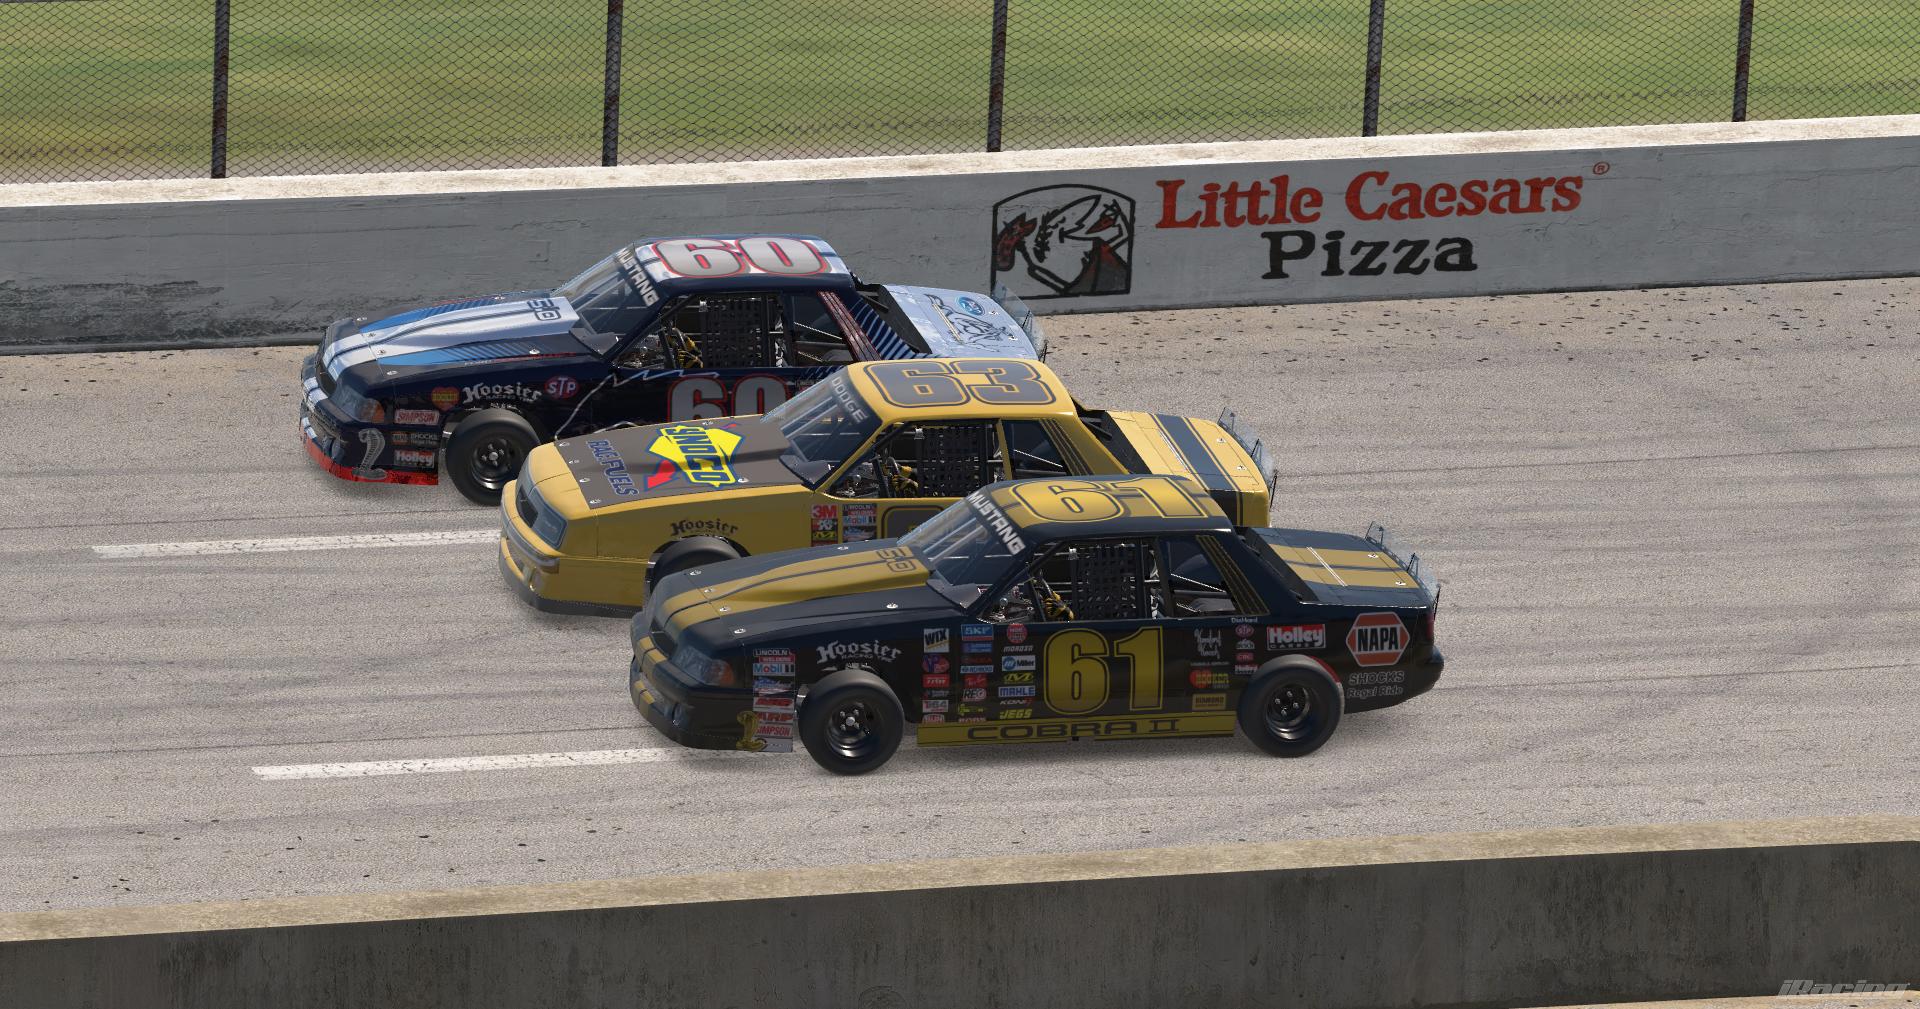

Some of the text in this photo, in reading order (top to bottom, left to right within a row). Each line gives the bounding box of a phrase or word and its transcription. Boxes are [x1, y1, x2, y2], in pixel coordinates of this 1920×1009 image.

[1155, 170, 1584, 229] Little Caesars
[651, 237, 831, 278] 60
[1261, 230, 1478, 280] Pizza
[616, 247, 660, 307] MUSTANG
[462, 382, 543, 404] Hoosier
[546, 377, 578, 396] STP
[862, 359, 1057, 408] 63
[831, 377, 869, 424] DODGE
[397, 411, 437, 424] SIMPSON
[395, 451, 434, 467] Holley
[1009, 477, 1208, 523] 61
[813, 504, 837, 519] 3M
[671, 518, 739, 536] Hoosier
[967, 492, 1027, 555] MUSTANG
[924, 630, 947, 646] WIX
[965, 626, 991, 635] SKF
[1268, 625, 1324, 647] Holley
[1357, 627, 1399, 652] NAPA
[816, 640, 902, 665] Hoosier
[753, 663, 783, 673] Mobil
[1043, 625, 1164, 716] 61
[1349, 671, 1405, 685] SHOCKS
[1000, 687, 1035, 696] MAHLE
[1001, 709, 1033, 719] JEGS
[967, 719, 1180, 741] COBRA II
